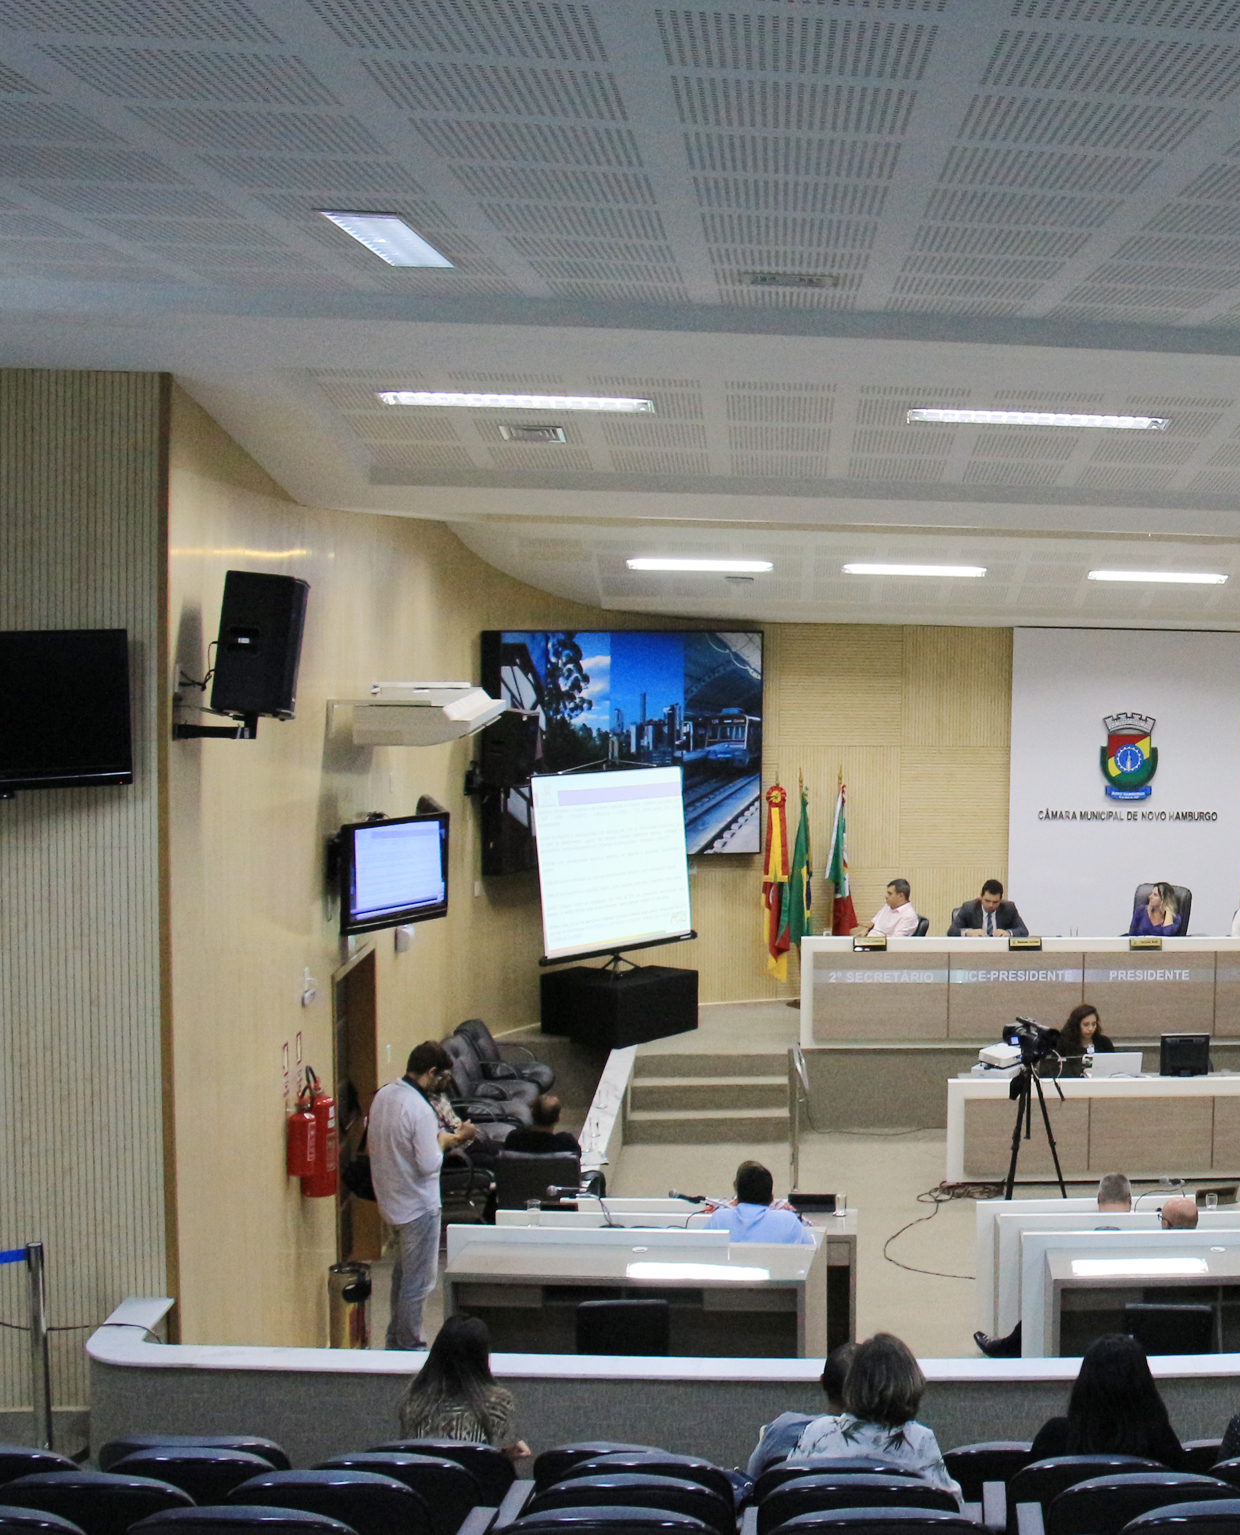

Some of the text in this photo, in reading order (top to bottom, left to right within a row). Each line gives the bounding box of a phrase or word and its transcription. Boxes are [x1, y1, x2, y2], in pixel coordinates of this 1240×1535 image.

[1037, 808, 1218, 822] CÂMARA MUNICIPAL DE NOVO HAMBURGO
[846, 970, 934, 983] SECRETÁRIO
[1109, 969, 1190, 981] PRESIDENTE
